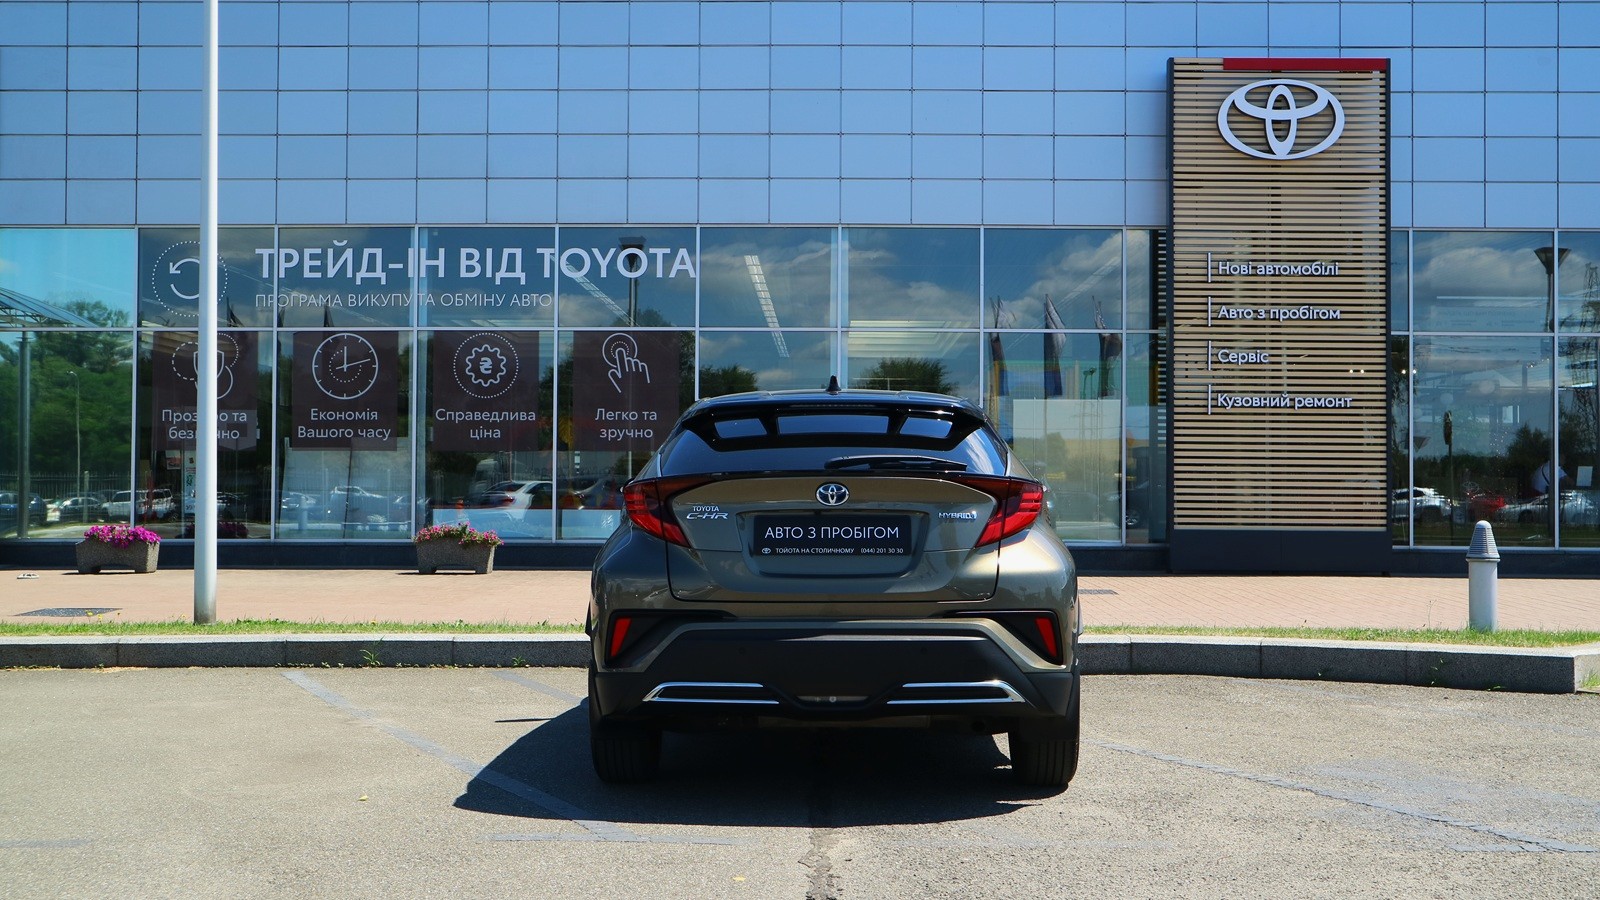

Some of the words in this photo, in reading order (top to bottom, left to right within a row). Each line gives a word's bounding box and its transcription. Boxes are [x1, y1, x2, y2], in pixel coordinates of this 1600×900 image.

[255, 240, 445, 285] ТРЕЙД-ІН
[460, 248, 525, 285] ВІД
[537, 247, 697, 278] TOYOTA
[1218, 261, 1252, 275] Нові
[1256, 261, 1339, 275] автомобілі
[255, 293, 343, 307] ПРОГРАМА
[348, 293, 413, 307] ВИКУПУ
[417, 293, 436, 306] ТА
[440, 293, 505, 307] ОБМІНУ
[509, 293, 552, 307] АВТО
[1218, 306, 1254, 319] Авто
[1257, 308, 1266, 319] з
[1270, 306, 1341, 322] пробігом
[1217, 350, 1269, 365] Сервіс
[1217, 393, 1290, 410] Кузовний
[1294, 397, 1353, 410] ремонт
[232, 412, 247, 421] та
[310, 408, 378, 421] Економія
[435, 408, 536, 422] Справедлива
[595, 408, 638, 421] Легко
[642, 410, 657, 421] та
[297, 426, 354, 438] Вашого
[358, 428, 391, 441] часу
[470, 426, 501, 439] ціна
[599, 428, 654, 440] зручно
[686, 512, 729, 520] C-HR
[764, 526, 803, 539] АВТО
[807, 526, 817, 539] З
[821, 526, 900, 539] ПРОБІГОМ
